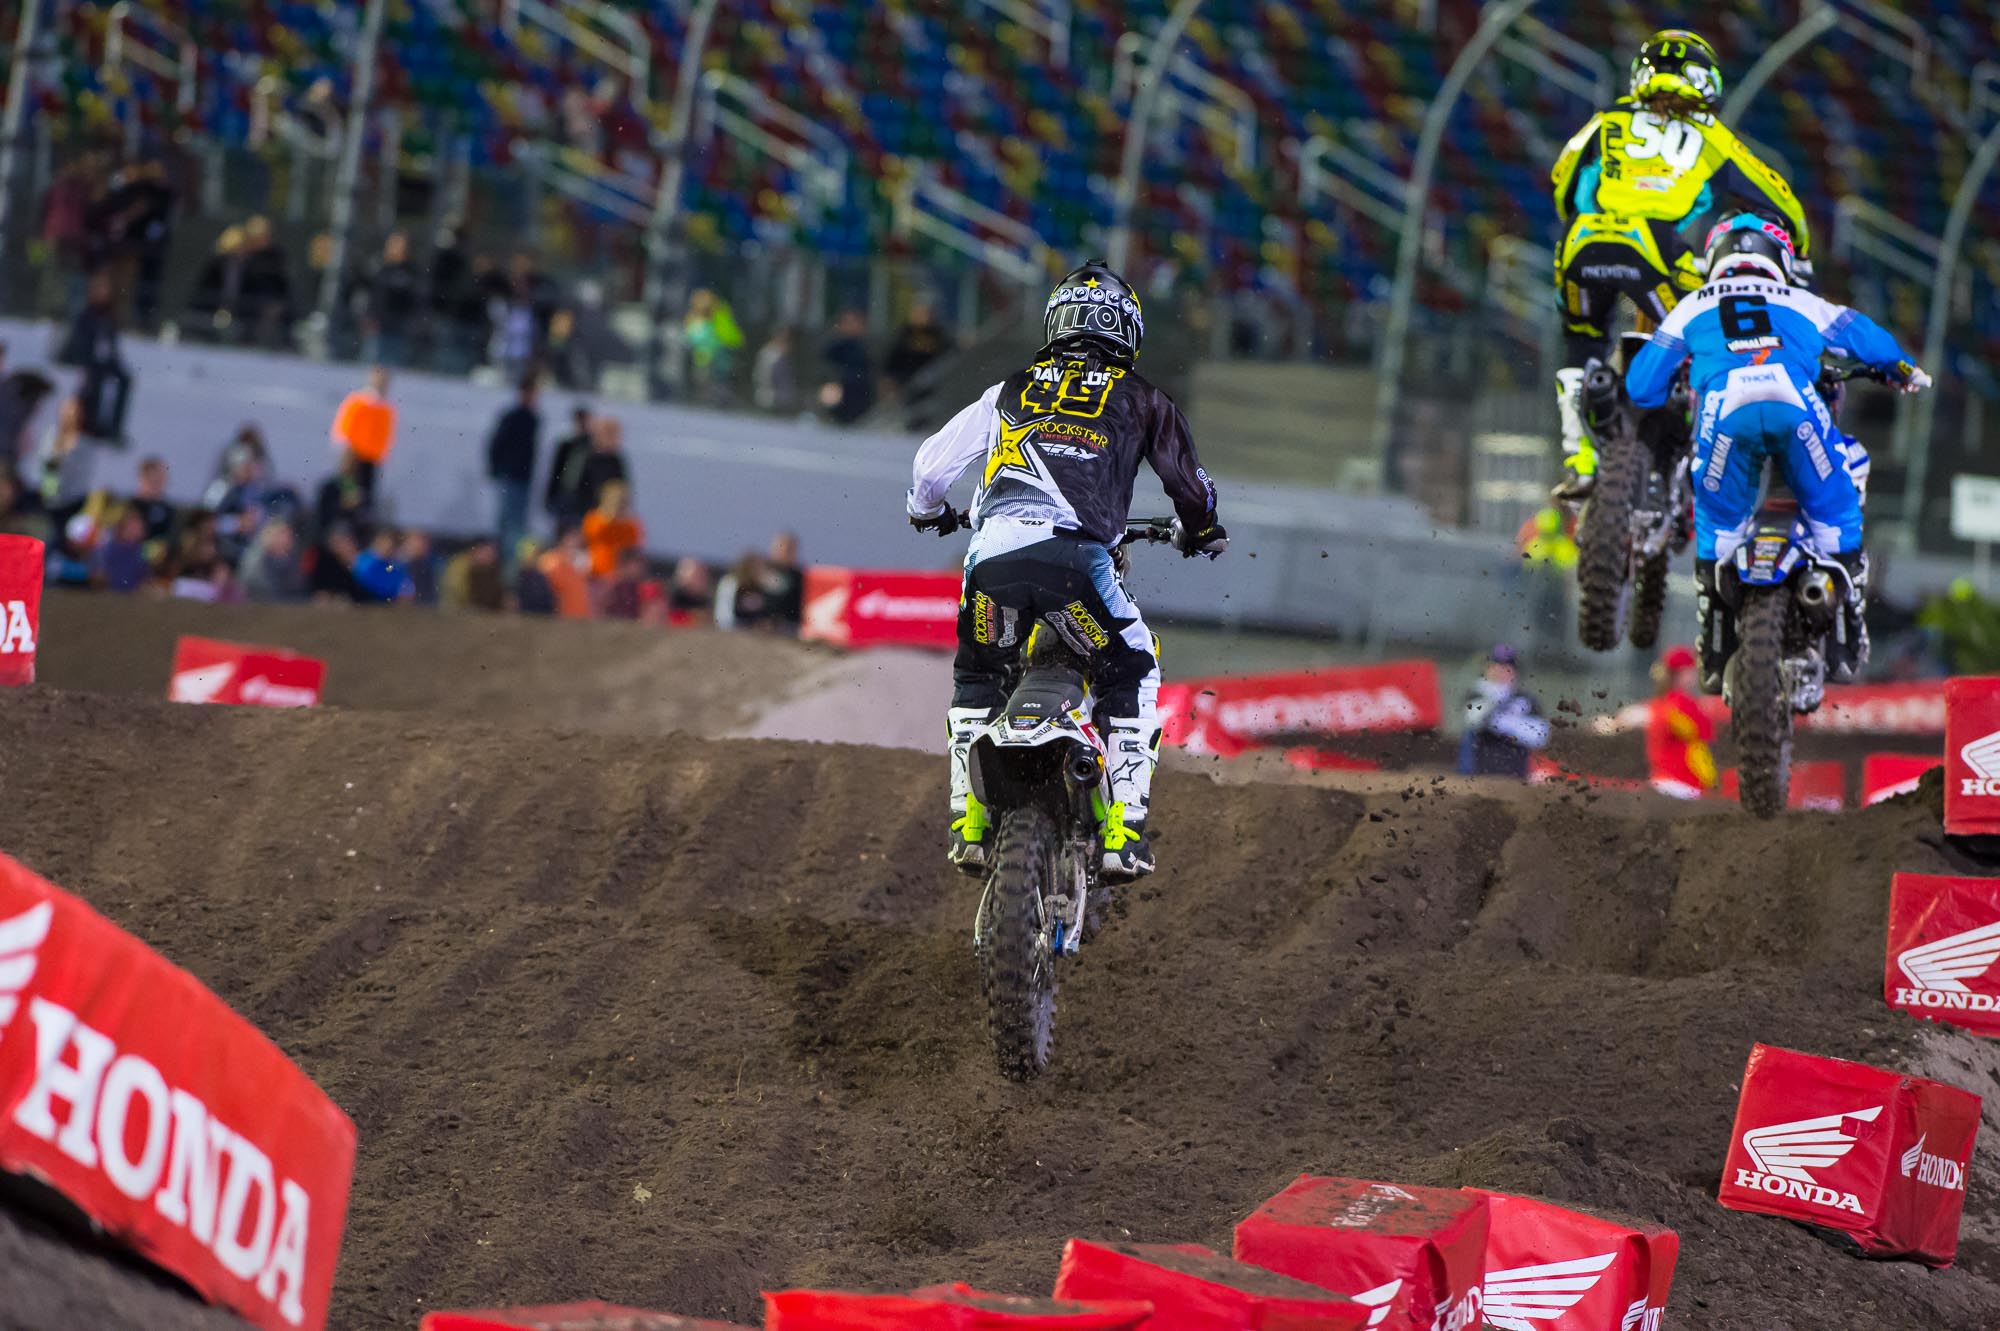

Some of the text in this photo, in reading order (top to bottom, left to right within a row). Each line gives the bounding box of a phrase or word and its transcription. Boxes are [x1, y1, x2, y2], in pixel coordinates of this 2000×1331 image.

[1623, 110, 1704, 171] 50
[1718, 294, 1772, 339] 6
[1034, 366, 1112, 386] DAVLOS
[1036, 421, 1109, 449] ROCKSTAR
[1706, 432, 1733, 480] YAMAHA
[1067, 602, 1109, 648] ROCKSTAR
[13, 995, 310, 1327] HONDA
[1733, 1168, 1865, 1214] HONDA
